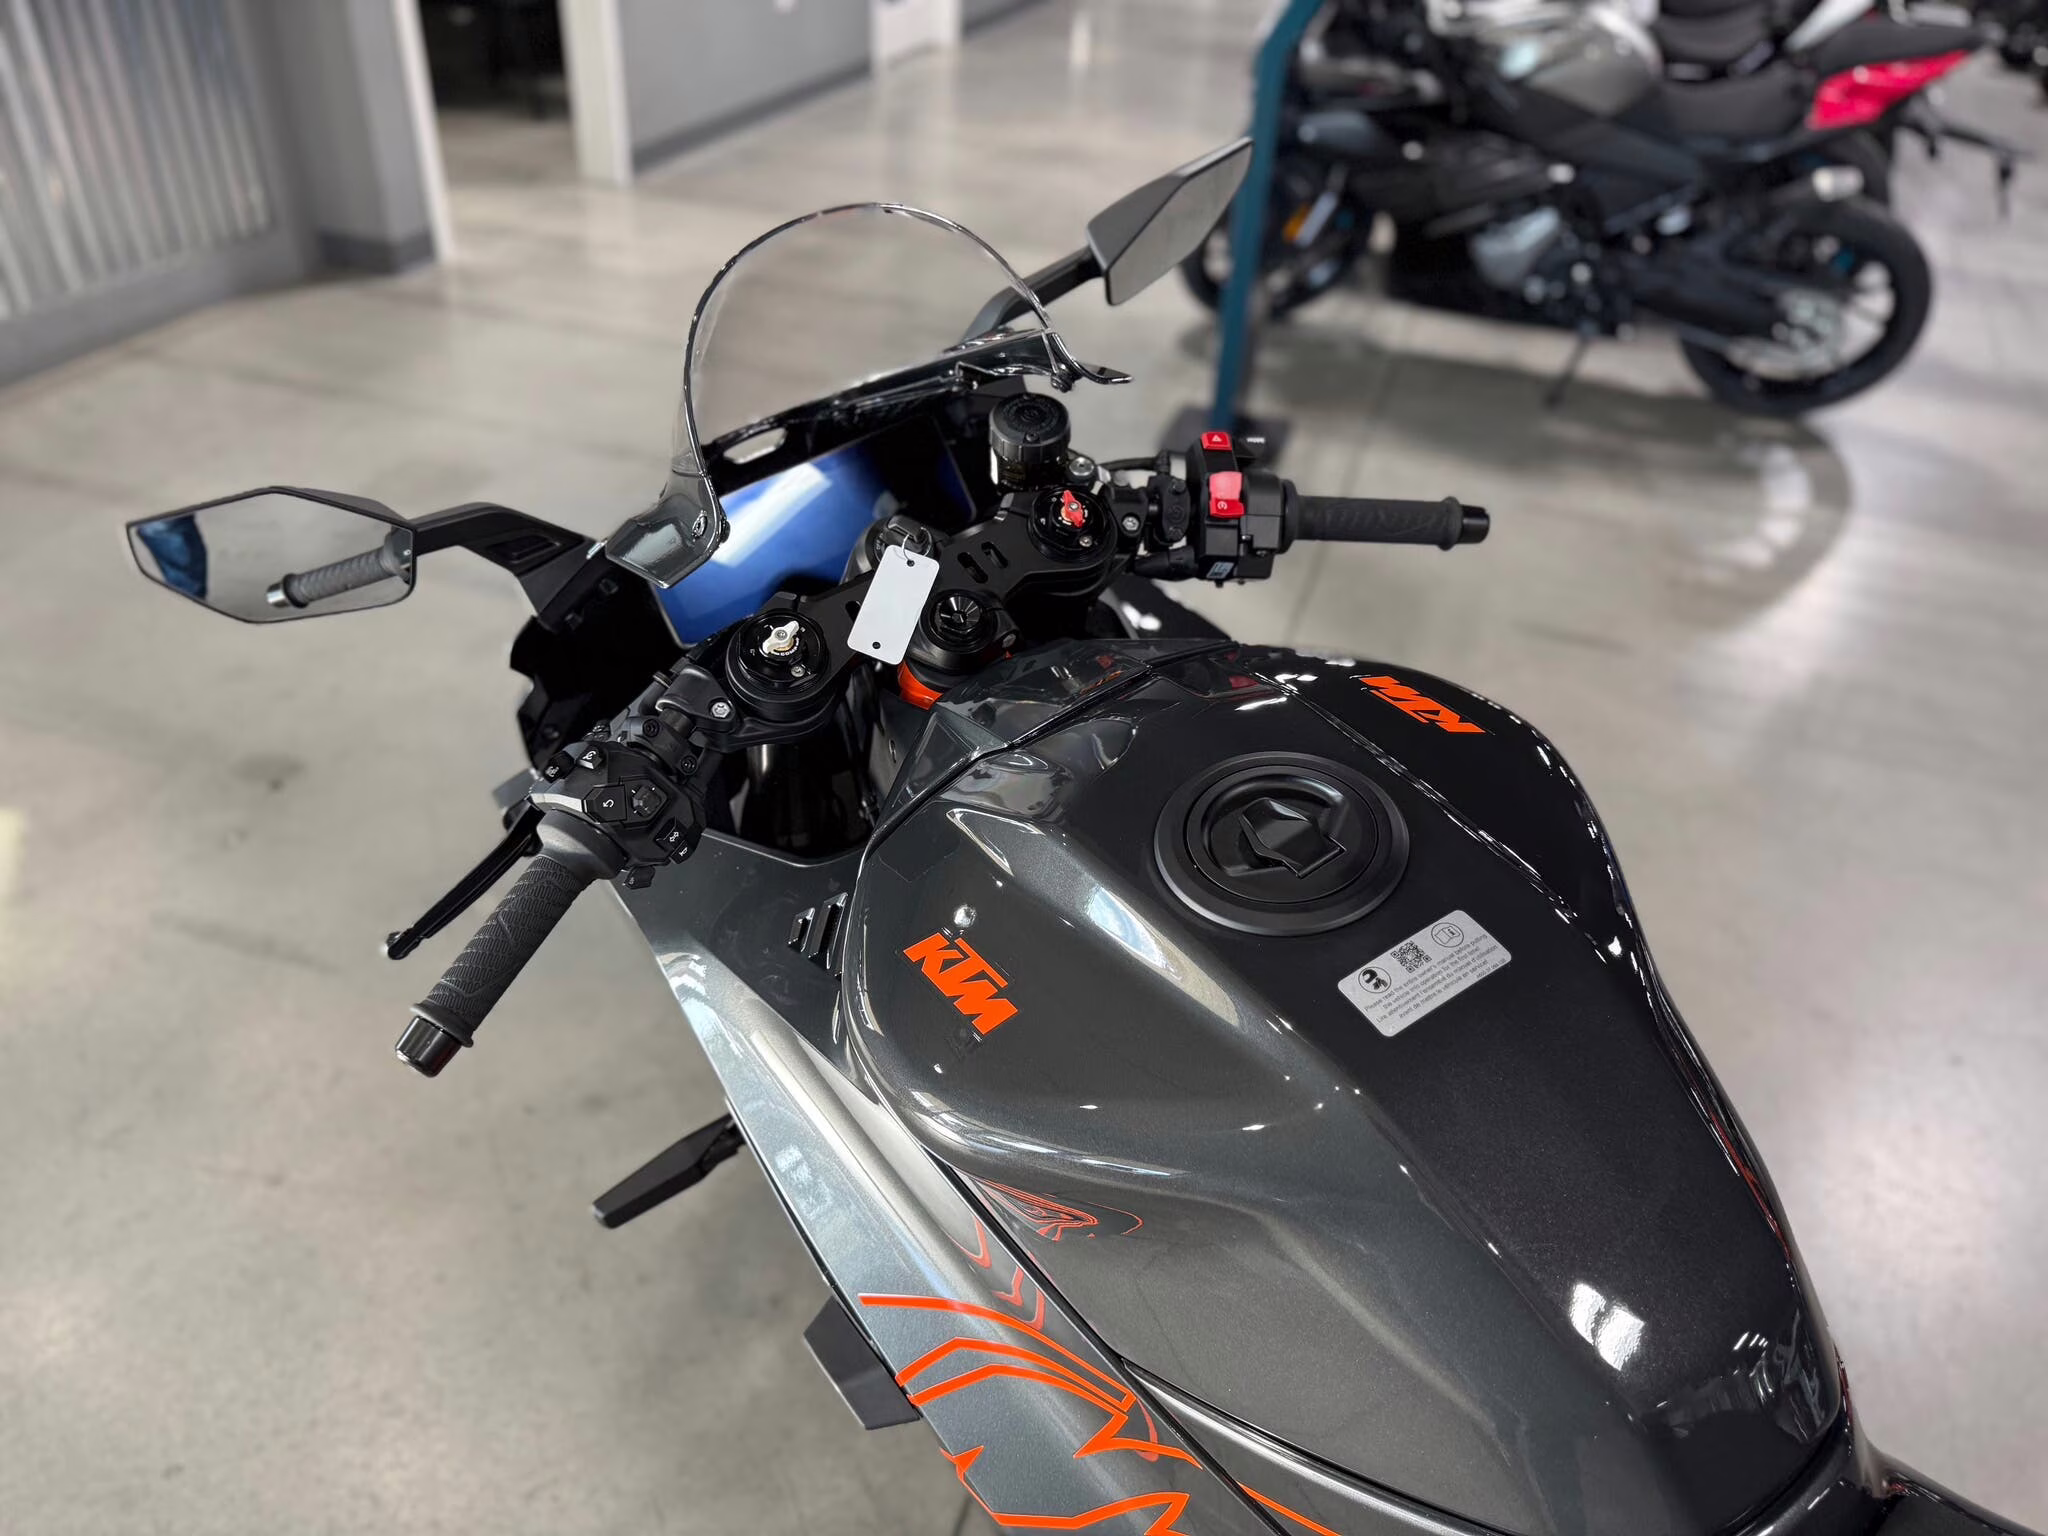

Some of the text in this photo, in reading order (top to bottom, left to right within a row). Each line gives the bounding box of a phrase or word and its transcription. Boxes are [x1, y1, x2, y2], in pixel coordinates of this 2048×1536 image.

[1359, 675, 1486, 734] KTM
[903, 932, 1018, 1035] KTM
[1364, 998, 1382, 1011] Please
[1382, 991, 1394, 1000] read
[1436, 953, 1455, 965] manual
[1454, 943, 1470, 954] before
[1391, 990, 1410, 1002] vehicle
[1420, 970, 1443, 986] operation
[1458, 953, 1468, 961] first
[1452, 960, 1472, 973] manuel
